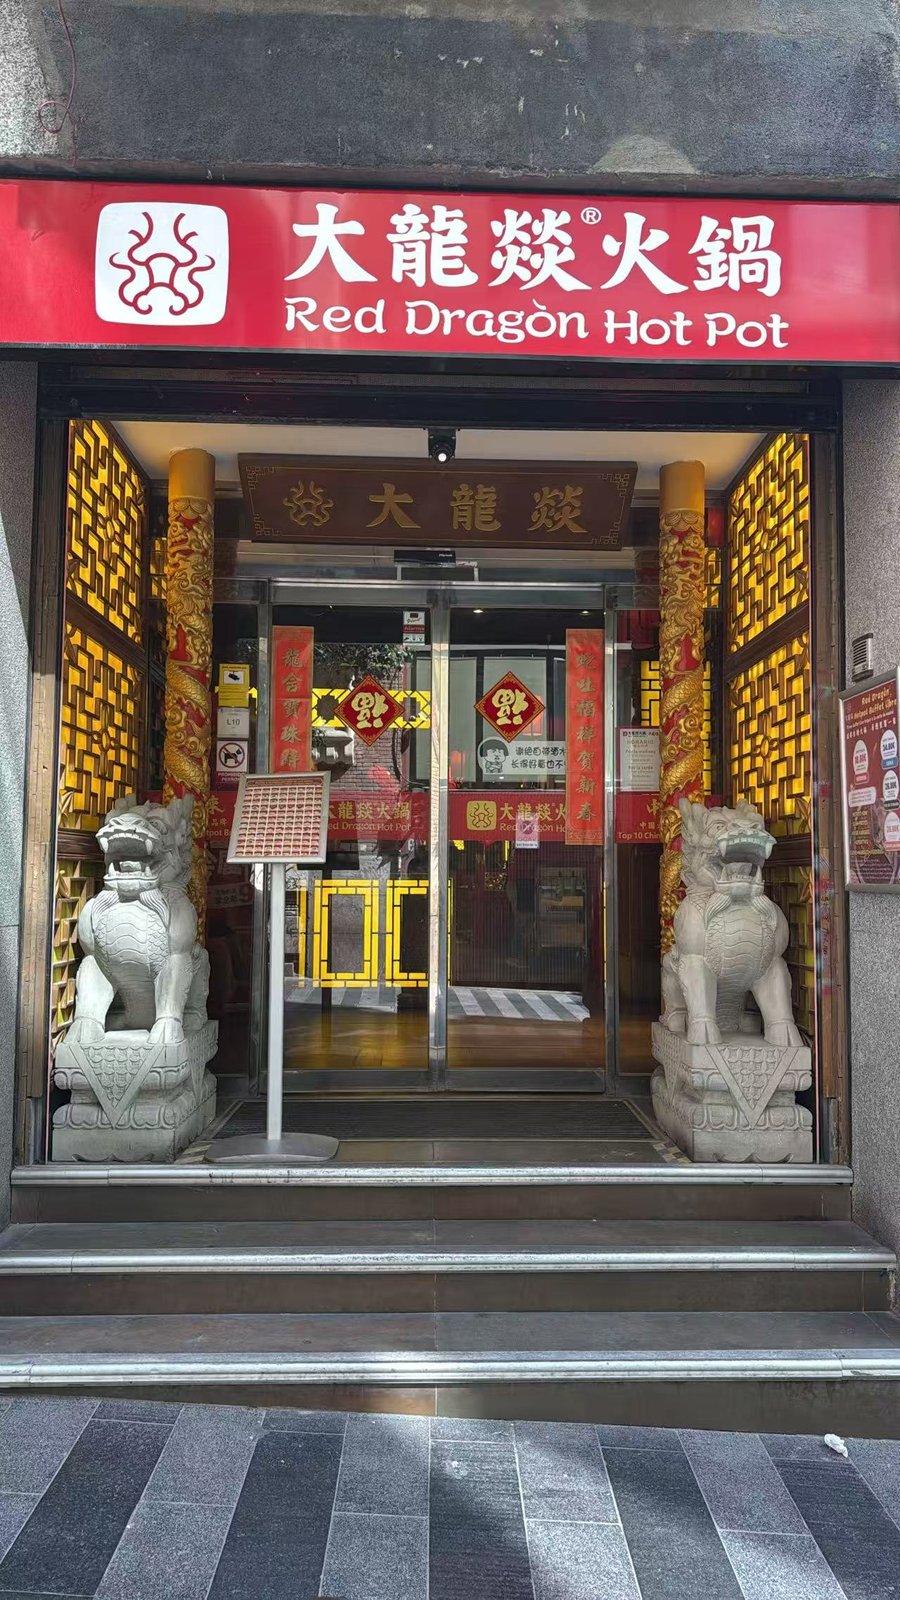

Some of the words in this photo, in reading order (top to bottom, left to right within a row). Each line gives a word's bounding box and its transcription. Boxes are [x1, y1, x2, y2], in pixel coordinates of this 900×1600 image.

[284, 297, 387, 334] Red
[604, 309, 693, 346] Hot
[703, 312, 789, 349] Pot
[365, 482, 588, 533] 大龍燚
[226, 718, 241, 726] L10
[511, 759, 566, 769] 长得好看也不
[618, 832, 632, 840] Top
